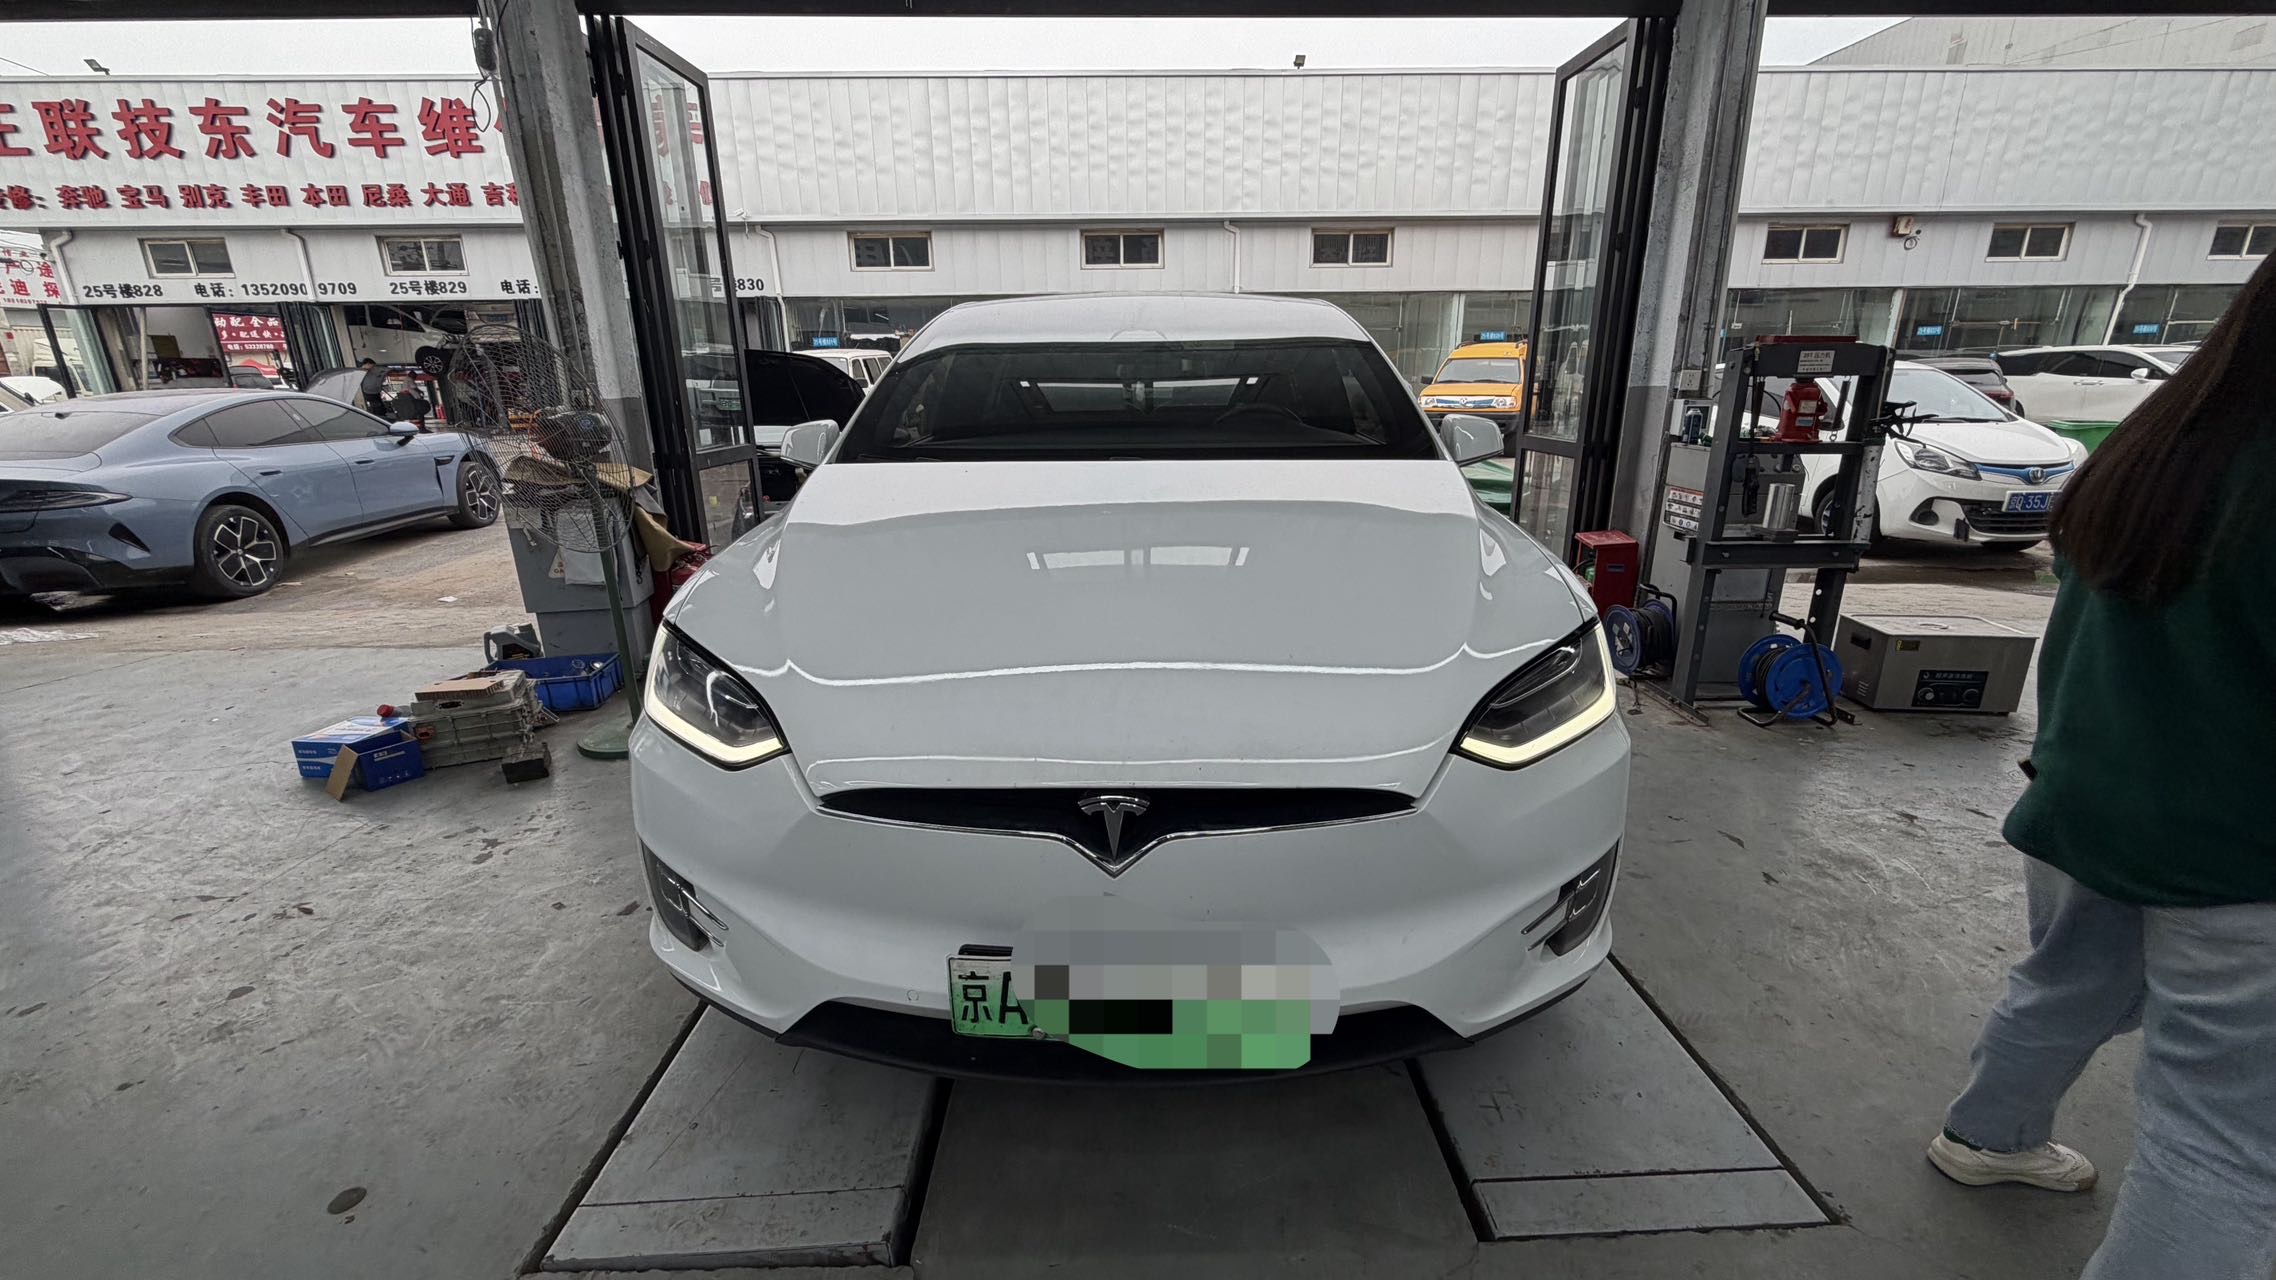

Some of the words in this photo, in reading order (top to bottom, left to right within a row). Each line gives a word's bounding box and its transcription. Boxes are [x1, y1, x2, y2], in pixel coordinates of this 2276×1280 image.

[0, 97, 503, 159] 联技东汽车维
[55, 185, 110, 209] 奔驰
[116, 185, 170, 209] 宝马
[241, 183, 291, 209] 丰田
[300, 183, 351, 208] 本田
[361, 183, 412, 207] 尼桑
[421, 182, 472, 207] 大通
[83, 284, 163, 298] 25号楼828
[389, 281, 467, 296] 25号楼829
[734, 278, 764, 291] 830
